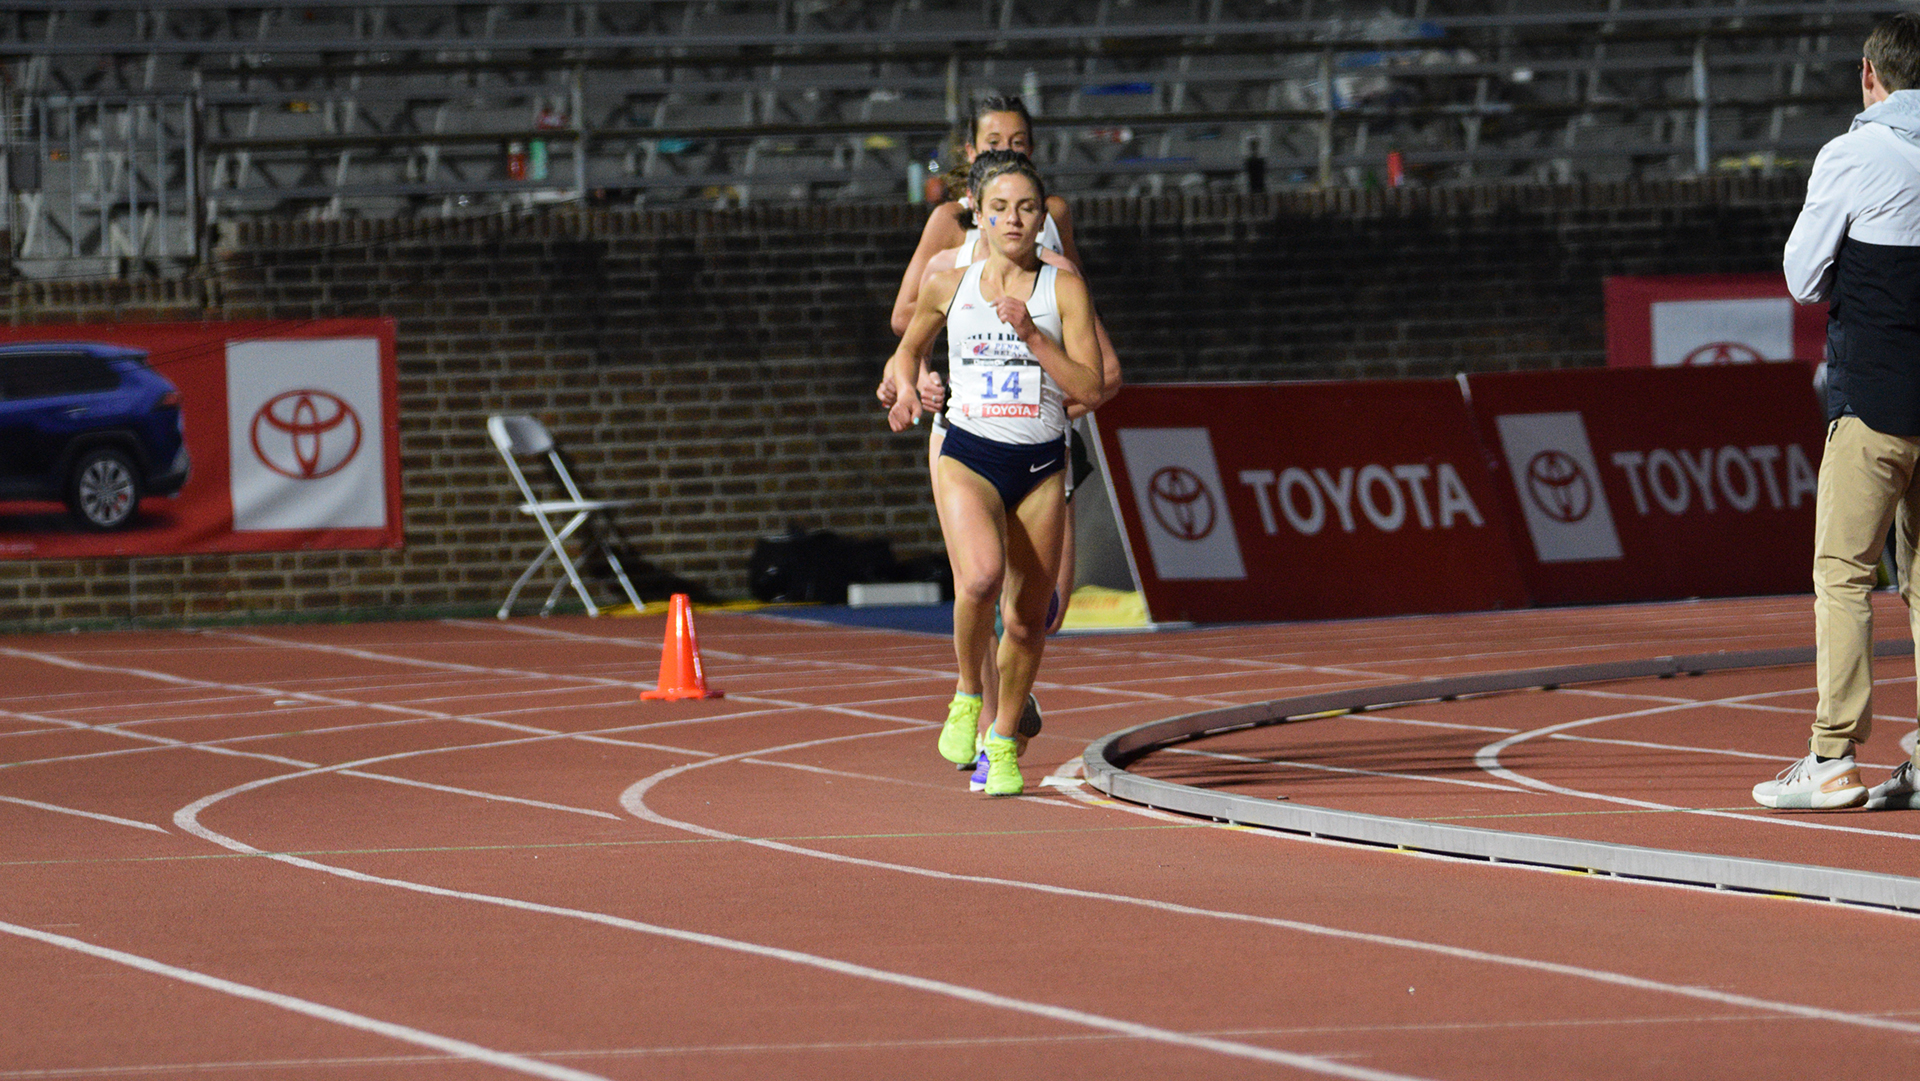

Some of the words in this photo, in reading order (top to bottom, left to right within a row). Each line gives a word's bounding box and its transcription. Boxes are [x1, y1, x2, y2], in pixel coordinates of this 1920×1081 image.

[981, 371, 1022, 399] 14
[985, 405, 1031, 415] TOYOTA
[1238, 463, 1485, 535] TOYOTA
[1612, 444, 1818, 514] TOYOTA
